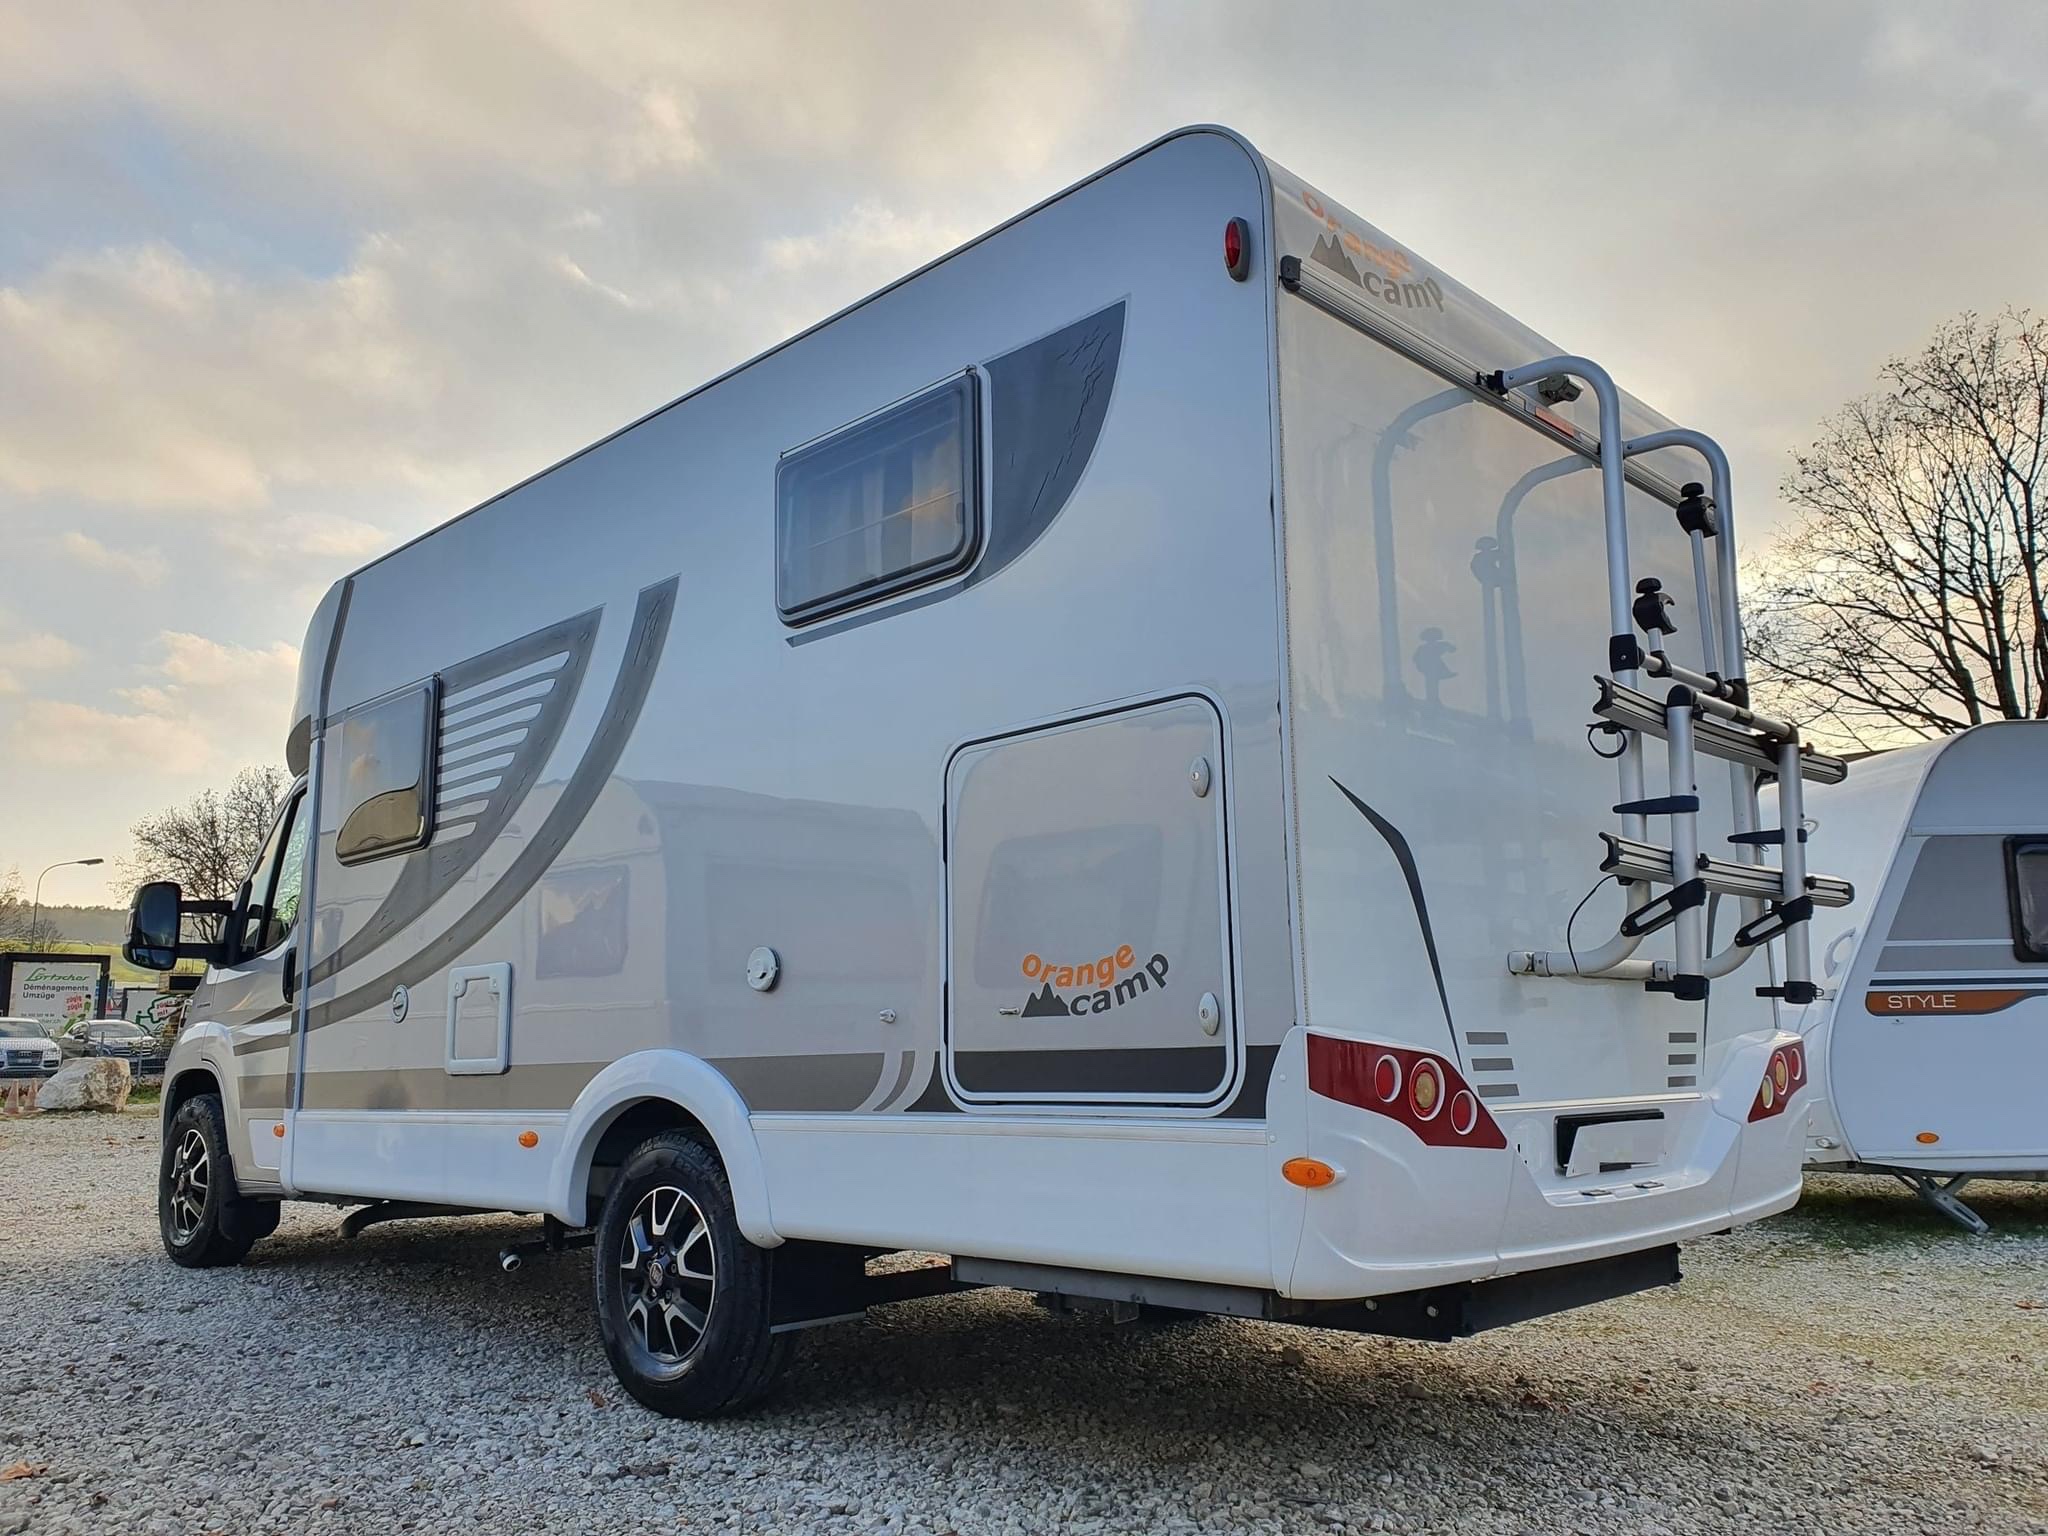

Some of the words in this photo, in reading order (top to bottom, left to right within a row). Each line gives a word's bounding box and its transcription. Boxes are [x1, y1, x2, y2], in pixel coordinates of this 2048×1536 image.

[1362, 271, 1444, 313] camp
[23, 983, 89, 992] Déménagements
[1070, 953, 1169, 1016] camp
[22, 992, 55, 1000] Umzüge
[1887, 994, 1957, 1009] STYLE
